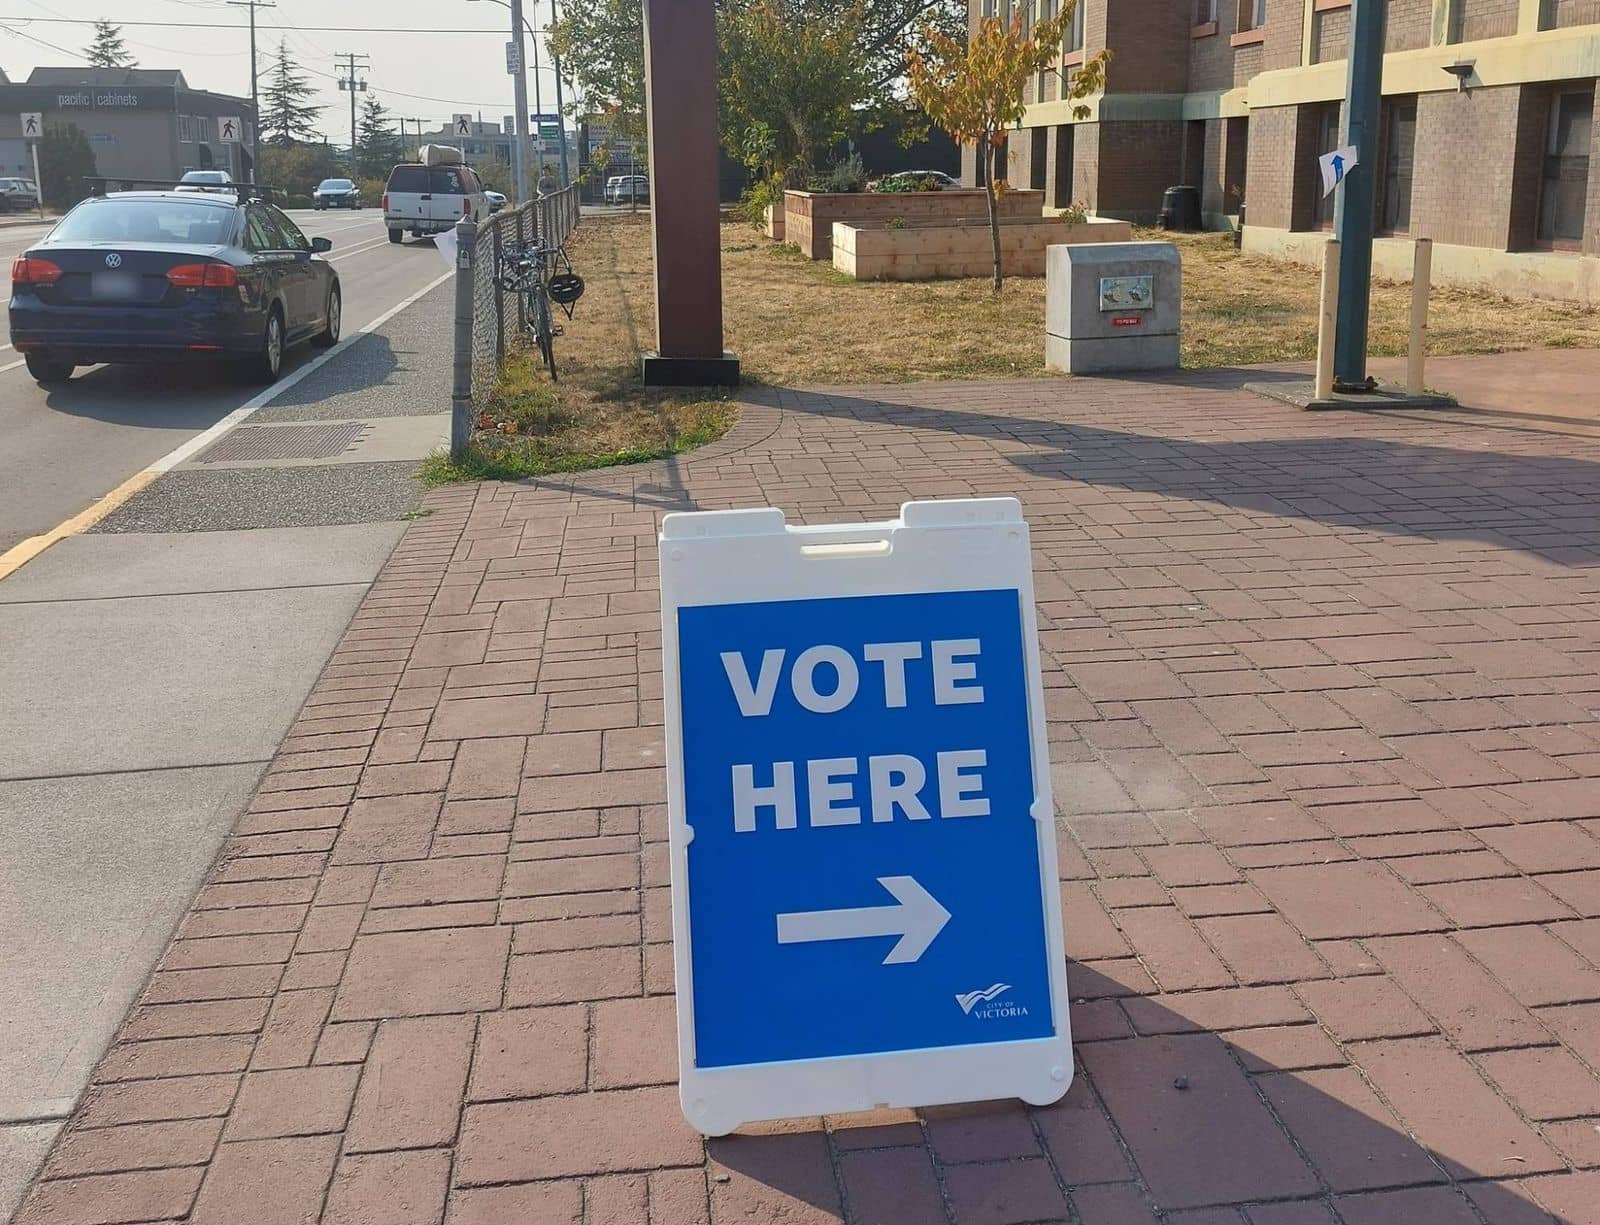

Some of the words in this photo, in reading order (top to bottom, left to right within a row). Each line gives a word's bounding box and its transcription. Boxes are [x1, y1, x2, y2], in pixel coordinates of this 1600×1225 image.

[58, 92, 89, 108] pacific
[97, 92, 137, 106] cabinets
[720, 638, 985, 717] VOTE
[731, 748, 991, 833] HERE
[974, 1007, 1029, 1019] VICTORIA
